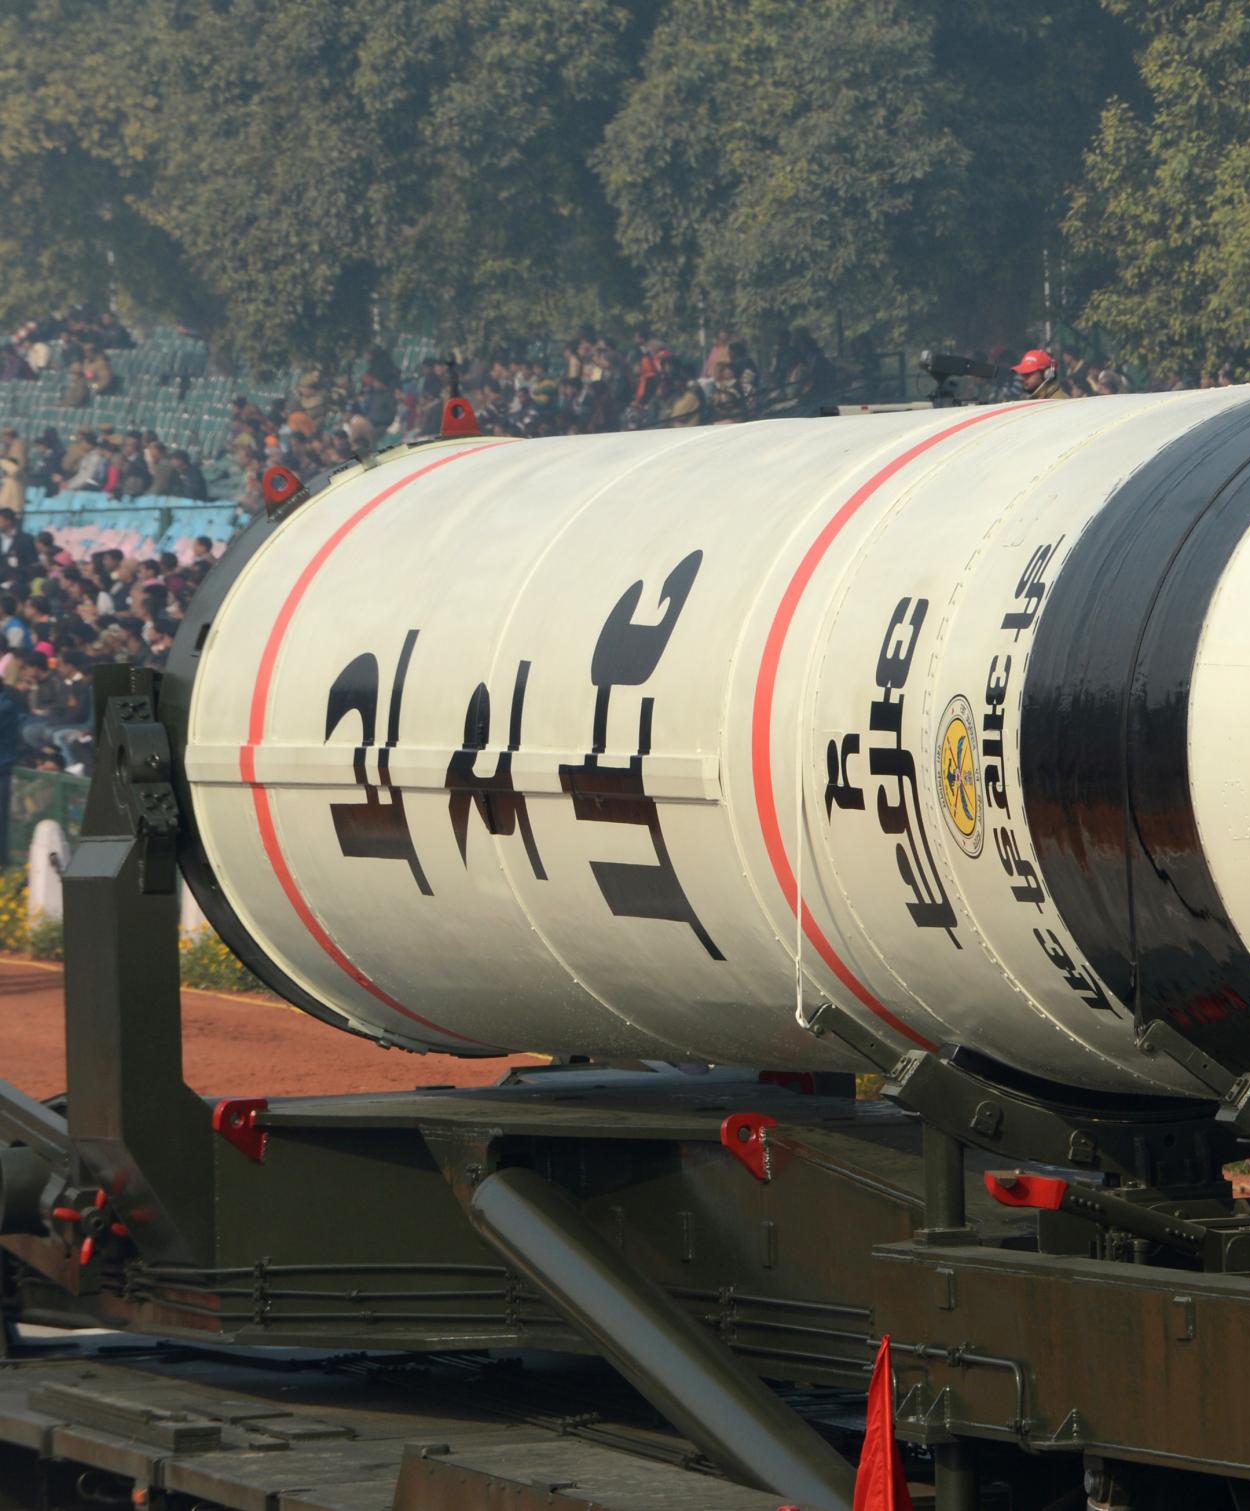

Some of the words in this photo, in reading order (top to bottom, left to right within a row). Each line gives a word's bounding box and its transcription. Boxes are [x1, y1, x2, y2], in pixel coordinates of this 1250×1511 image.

[1001, 533, 1066, 643] डी
[869, 597, 963, 950] अग्नि
[982, 653, 1012, 821] आर
[993, 827, 1046, 914] डी
